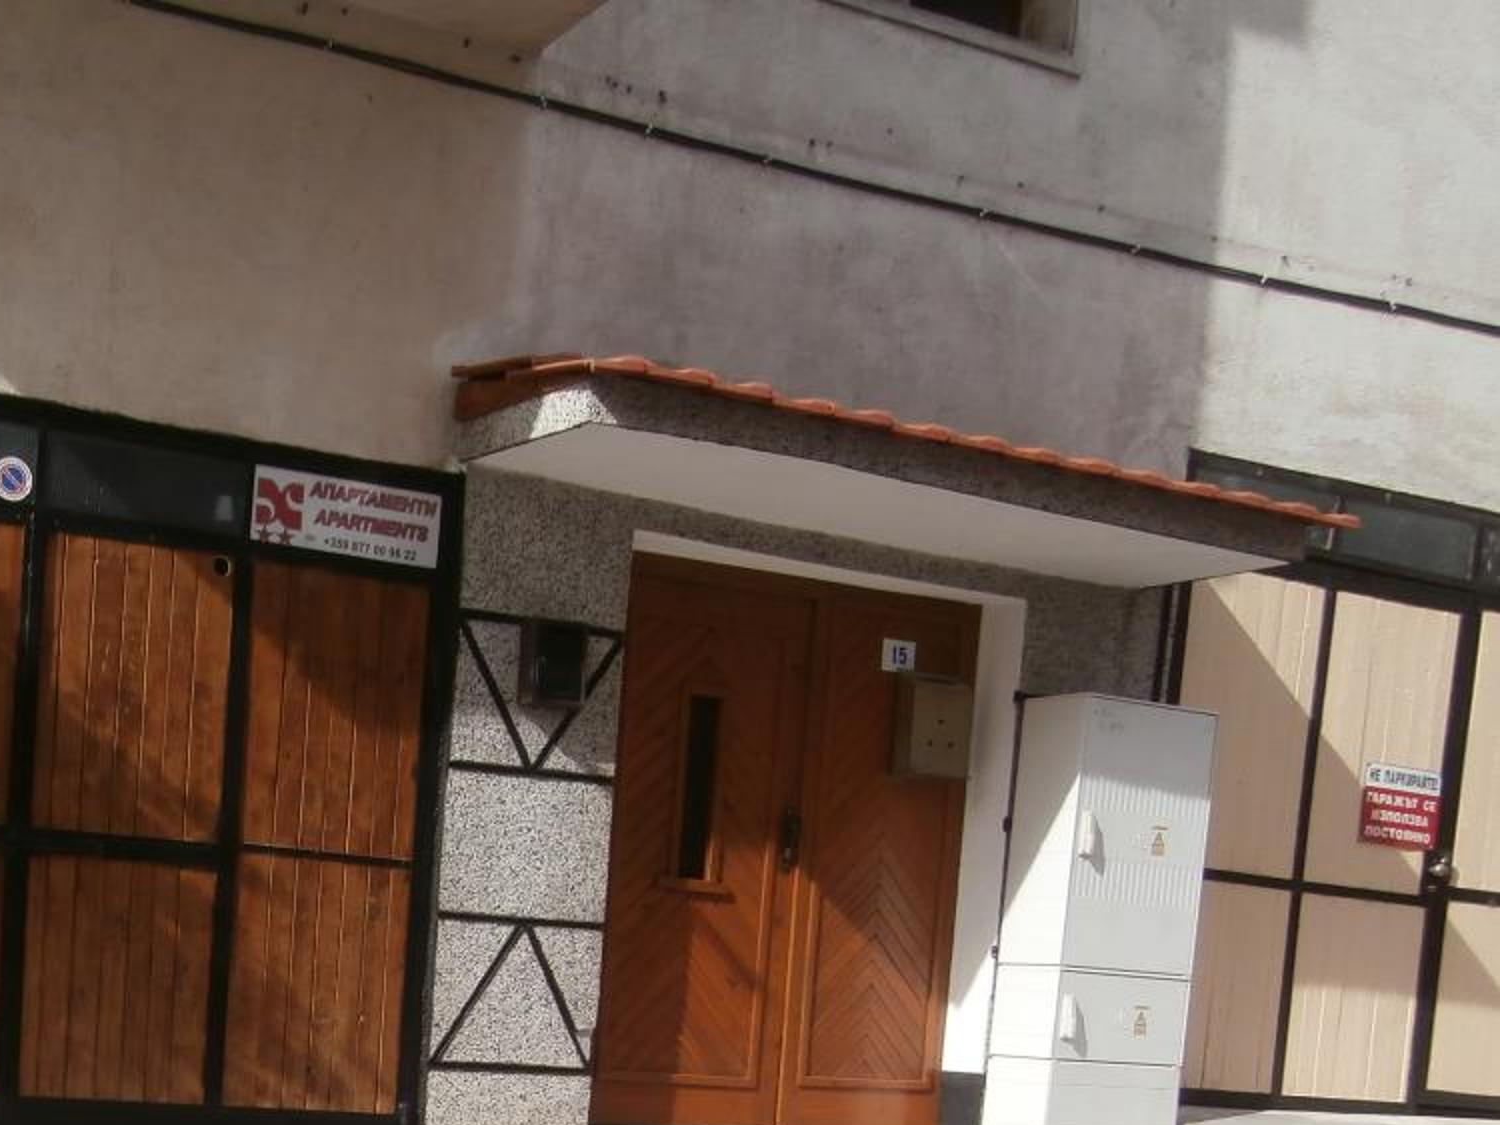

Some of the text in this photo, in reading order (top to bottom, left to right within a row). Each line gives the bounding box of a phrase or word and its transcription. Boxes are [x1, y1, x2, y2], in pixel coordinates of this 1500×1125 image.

[310, 481, 437, 519] АПАРТАМЕНТИ
[314, 509, 429, 543] APARTMENTS
[893, 645, 907, 665] 15
[1423, 800, 1437, 813] СЕ
[1364, 825, 1430, 844] ПОСТОЯННО
